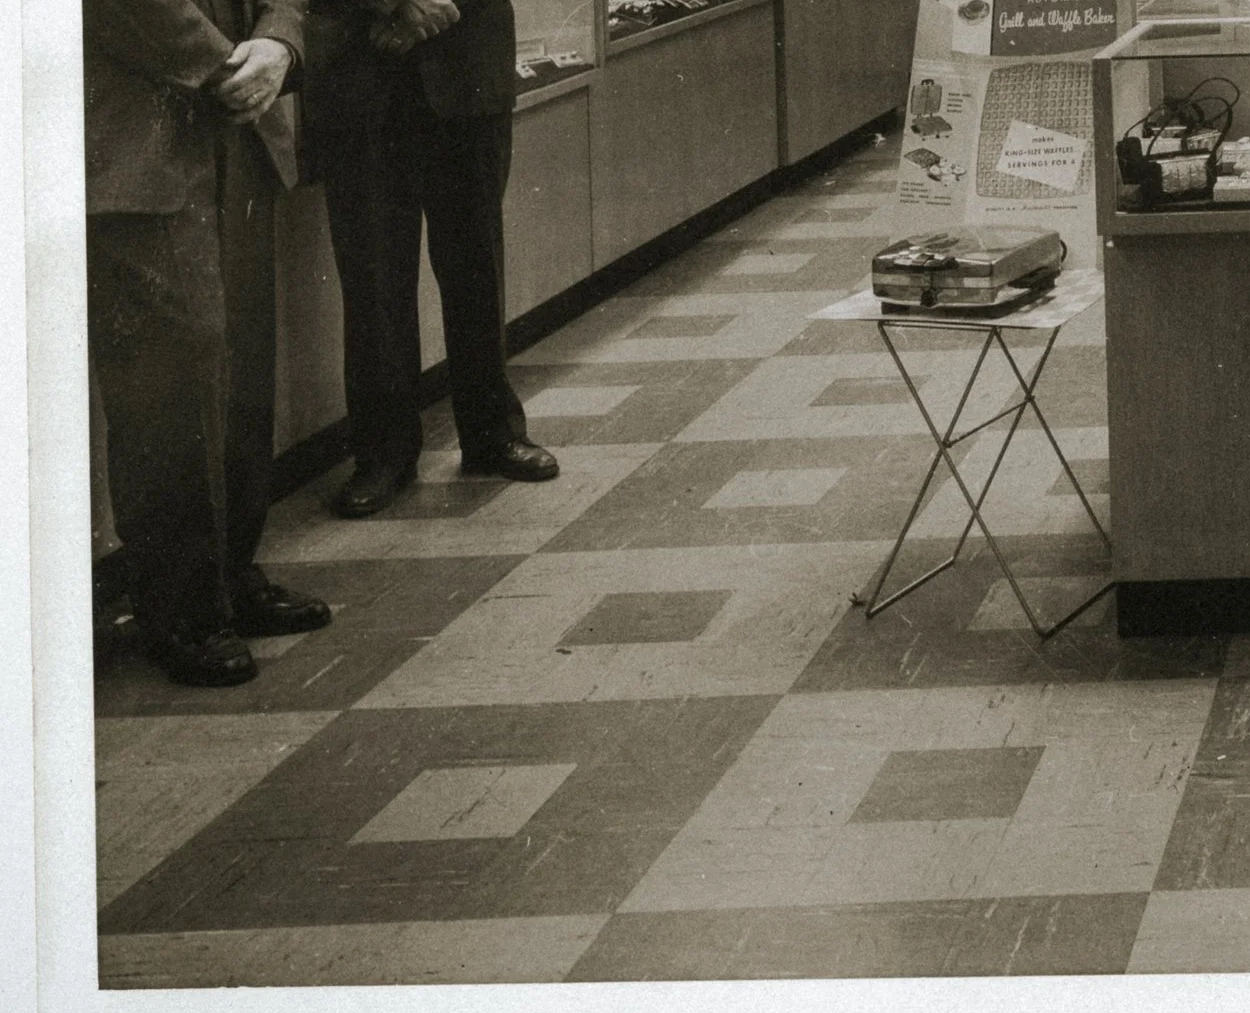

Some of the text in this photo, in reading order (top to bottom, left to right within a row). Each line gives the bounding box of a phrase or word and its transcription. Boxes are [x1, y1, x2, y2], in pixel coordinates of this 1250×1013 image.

[999, 7, 1116, 33] Grill and Waffle Baker
[1007, 160, 1048, 168] SERVINGS
